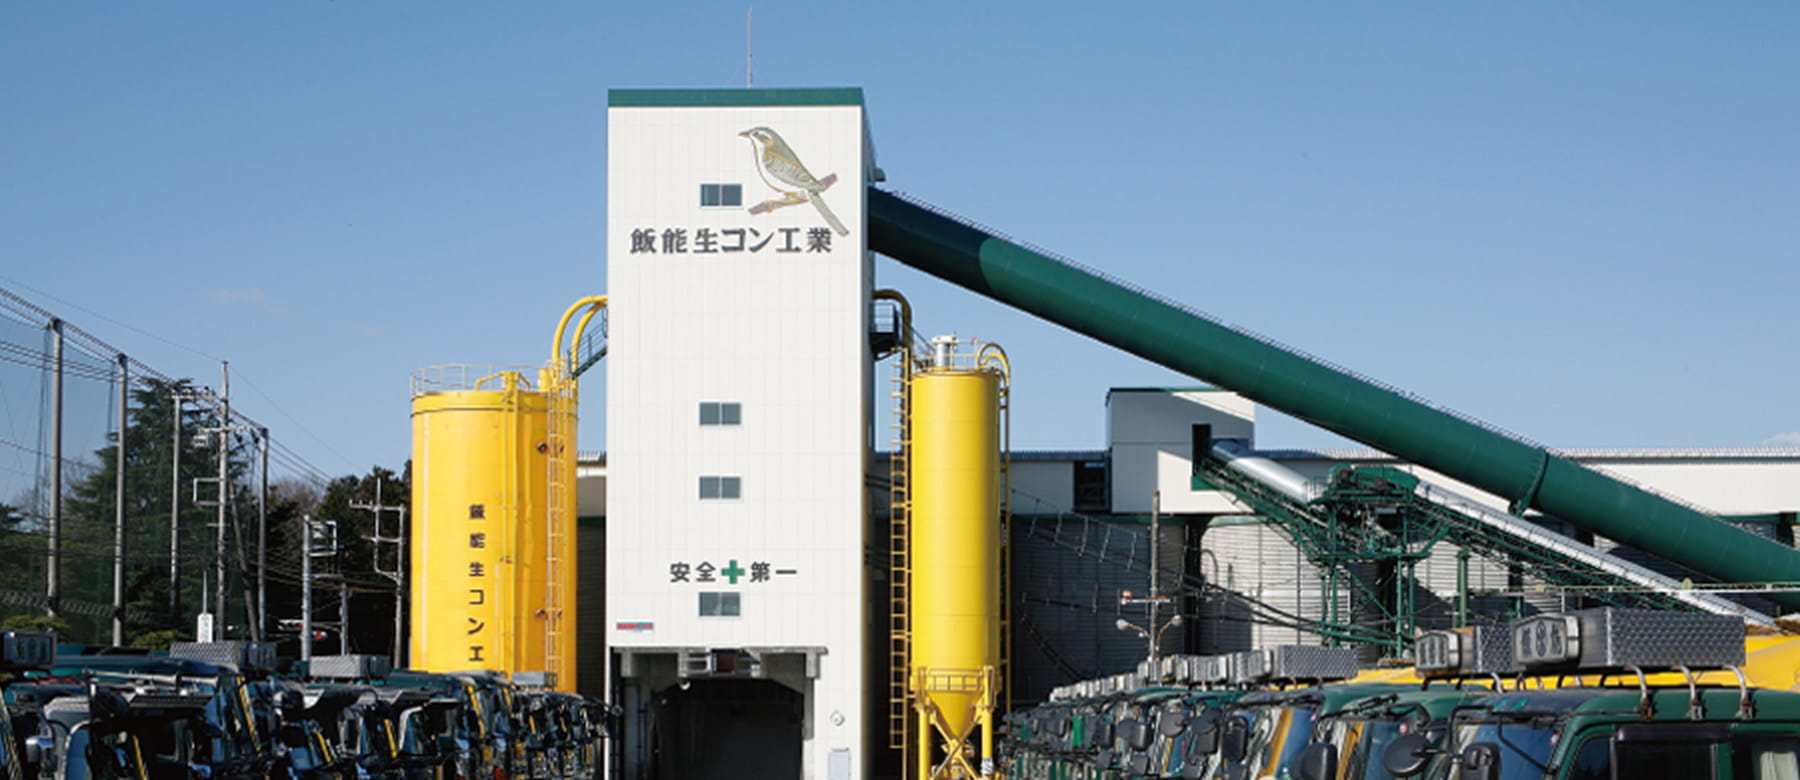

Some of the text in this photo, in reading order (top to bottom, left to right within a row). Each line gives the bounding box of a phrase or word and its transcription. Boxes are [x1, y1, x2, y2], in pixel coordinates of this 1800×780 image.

[629, 227, 832, 254] 飯能生コン工業
